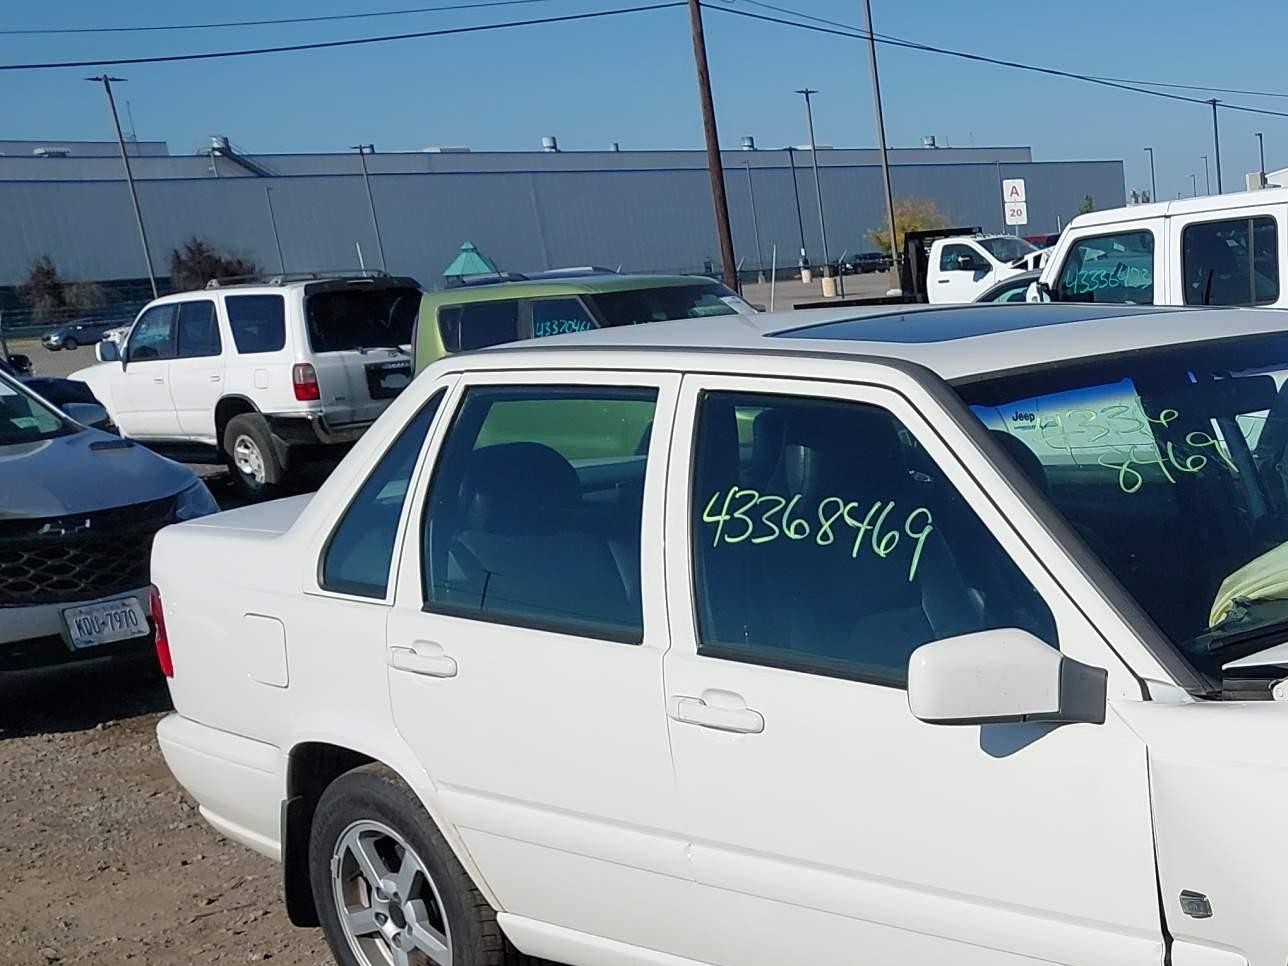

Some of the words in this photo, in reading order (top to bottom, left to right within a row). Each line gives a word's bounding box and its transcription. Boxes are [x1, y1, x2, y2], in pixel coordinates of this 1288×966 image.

[1010, 185, 1020, 197] A
[1010, 208, 1023, 217] 20
[1012, 410, 1035, 422] Jeep
[1097, 431, 1239, 493] 8469
[702, 486, 933, 581] 43368469
